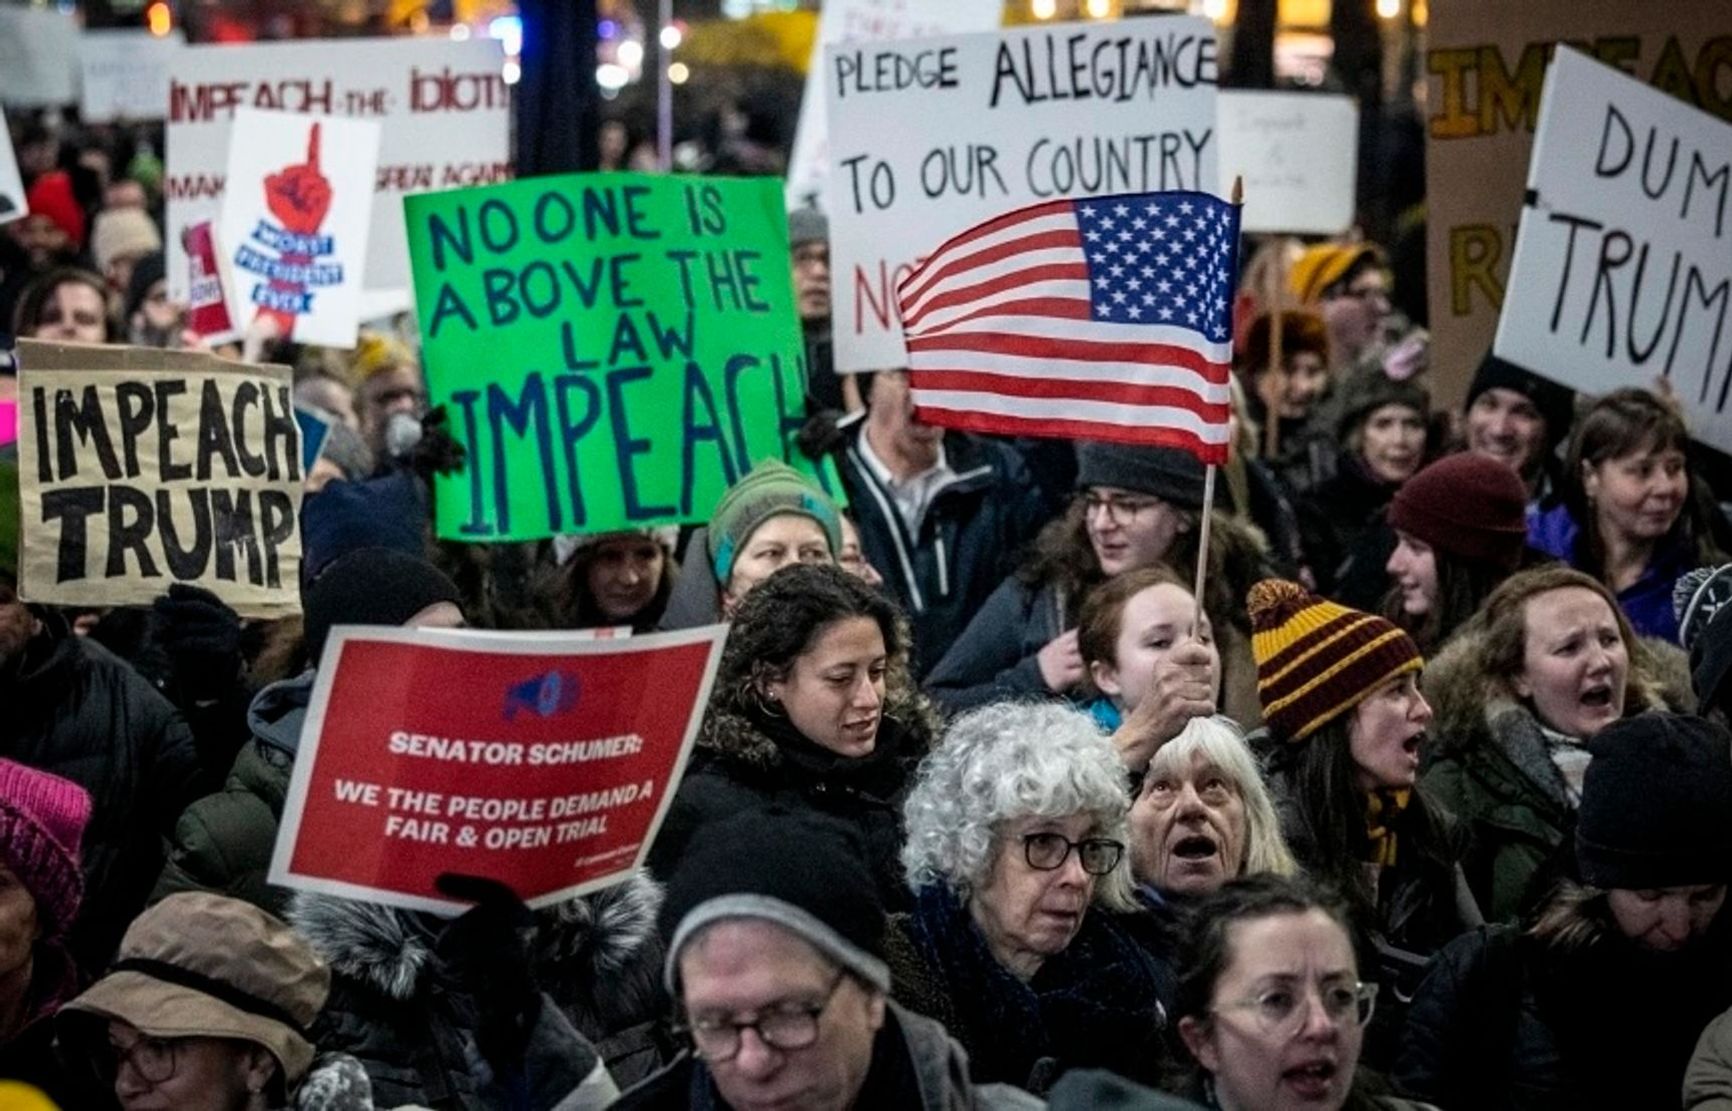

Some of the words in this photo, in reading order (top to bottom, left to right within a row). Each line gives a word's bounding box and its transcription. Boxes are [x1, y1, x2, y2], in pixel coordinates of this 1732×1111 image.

[836, 47, 959, 98] PLEDGE
[988, 32, 1220, 110] ALLEGIANCE
[840, 154, 896, 214] TO
[920, 143, 1010, 199] OUR
[1026, 127, 1213, 199] COUNTRY
[427, 199, 519, 272] NO
[533, 186, 661, 244] ONE
[685, 184, 727, 237] IS
[429, 253, 646, 339] ABOVE
[666, 249, 771, 313] THE
[1548, 213, 1732, 414] TRUM
[563, 309, 696, 372] LAW
[33, 378, 300, 484] IMPEACH
[41, 484, 294, 589] TRUMP
[387, 731, 523, 765] SENATOR
[527, 732, 645, 766] SCHUMER:
[334, 778, 382, 806] WE
[386, 786, 443, 815] THE
[447, 795, 546, 821] PEOPLE
[549, 783, 639, 819] DEMAND
[636, 779, 655, 801] A
[384, 815, 450, 844] FAIR
[454, 824, 480, 848] &
[484, 826, 552, 850] OPEN
[555, 815, 609, 845] TRIAL
